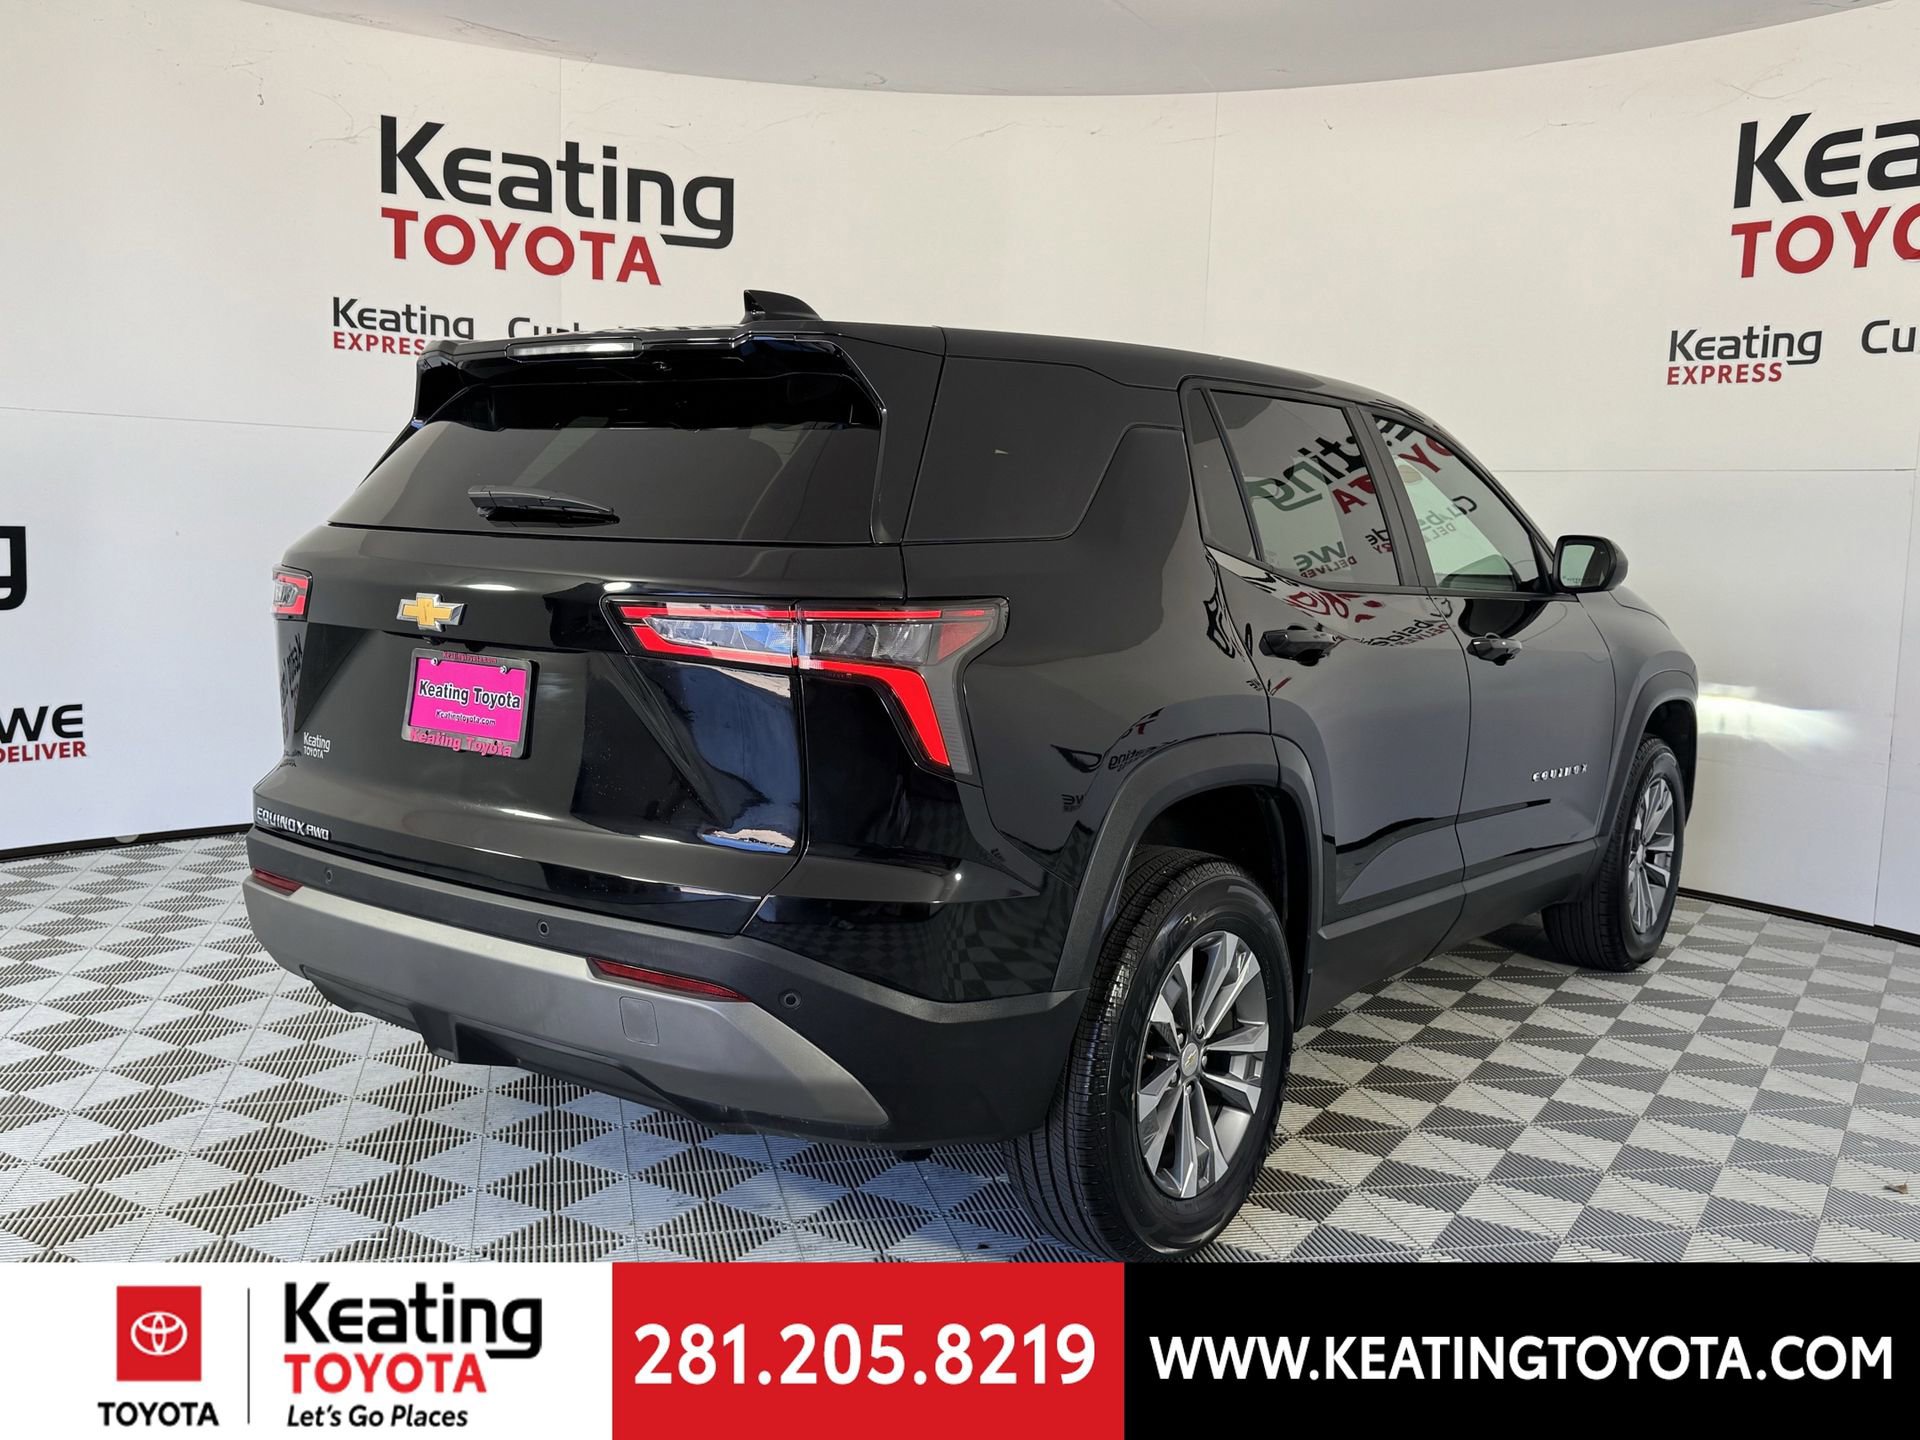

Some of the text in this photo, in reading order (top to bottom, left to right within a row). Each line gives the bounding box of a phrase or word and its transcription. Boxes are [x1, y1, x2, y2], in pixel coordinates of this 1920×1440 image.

[380, 115, 734, 249] Keating
[381, 206, 662, 286] TOYOTA
[333, 296, 474, 340] Keating
[333, 331, 426, 356] EXPRES
[1668, 325, 1822, 366] Keating
[1666, 362, 1783, 385] EXPRESS
[418, 680, 521, 709] Keating Toyota
[0, 704, 83, 744] WE
[303, 732, 331, 753] Keating
[303, 746, 324, 759] TOYOTA
[409, 728, 512, 757] Keating Toyota
[1531, 763, 1588, 782] EQUINOX
[256, 807, 306, 836] EQUINOX
